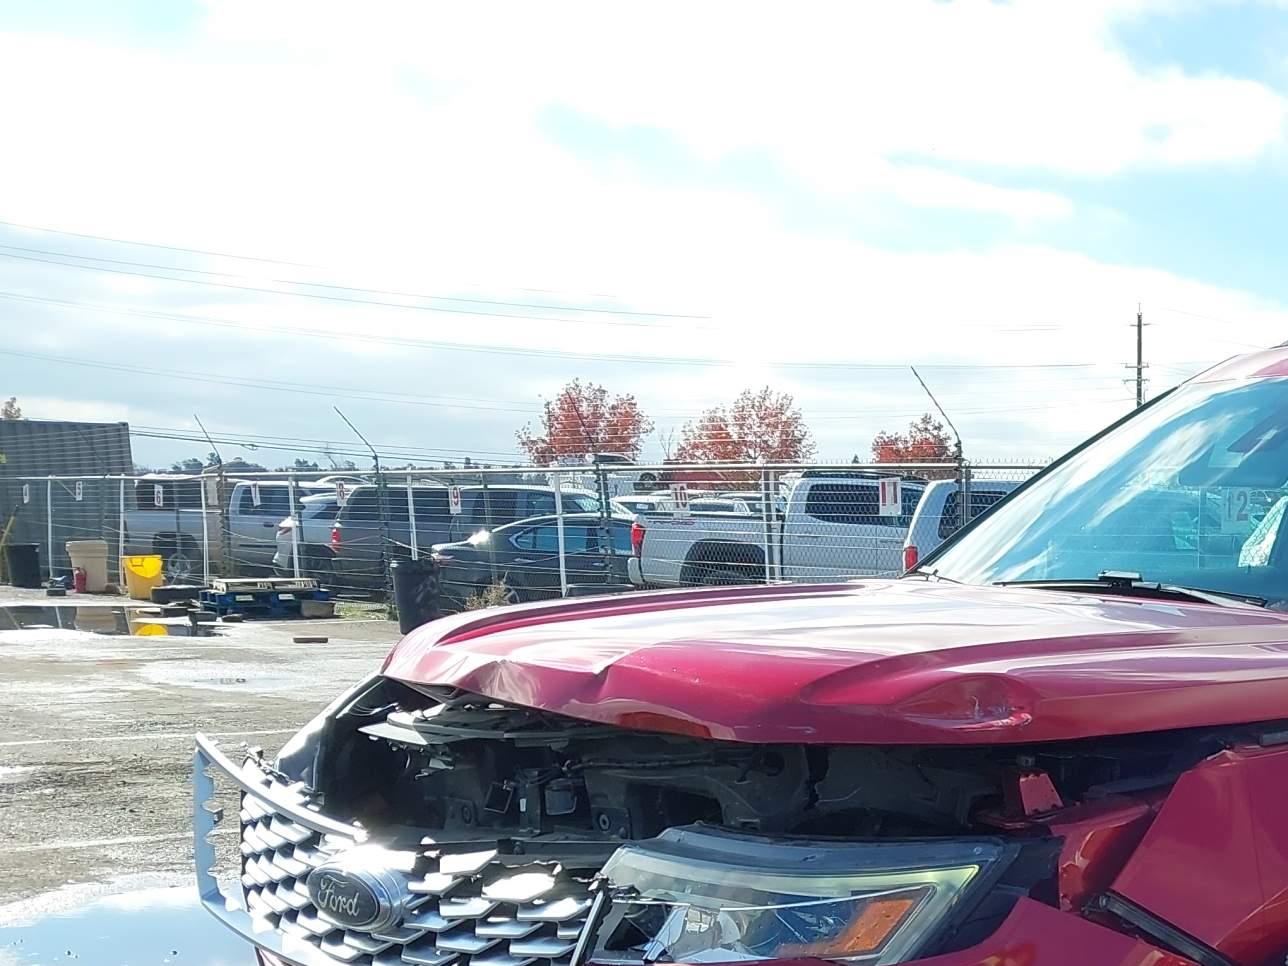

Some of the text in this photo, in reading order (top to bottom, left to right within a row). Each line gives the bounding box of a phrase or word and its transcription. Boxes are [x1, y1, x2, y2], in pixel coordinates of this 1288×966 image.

[674, 484, 688, 509] 10
[880, 481, 898, 507] 11
[1226, 490, 1249, 522] 12
[317, 874, 361, 917] Ford
